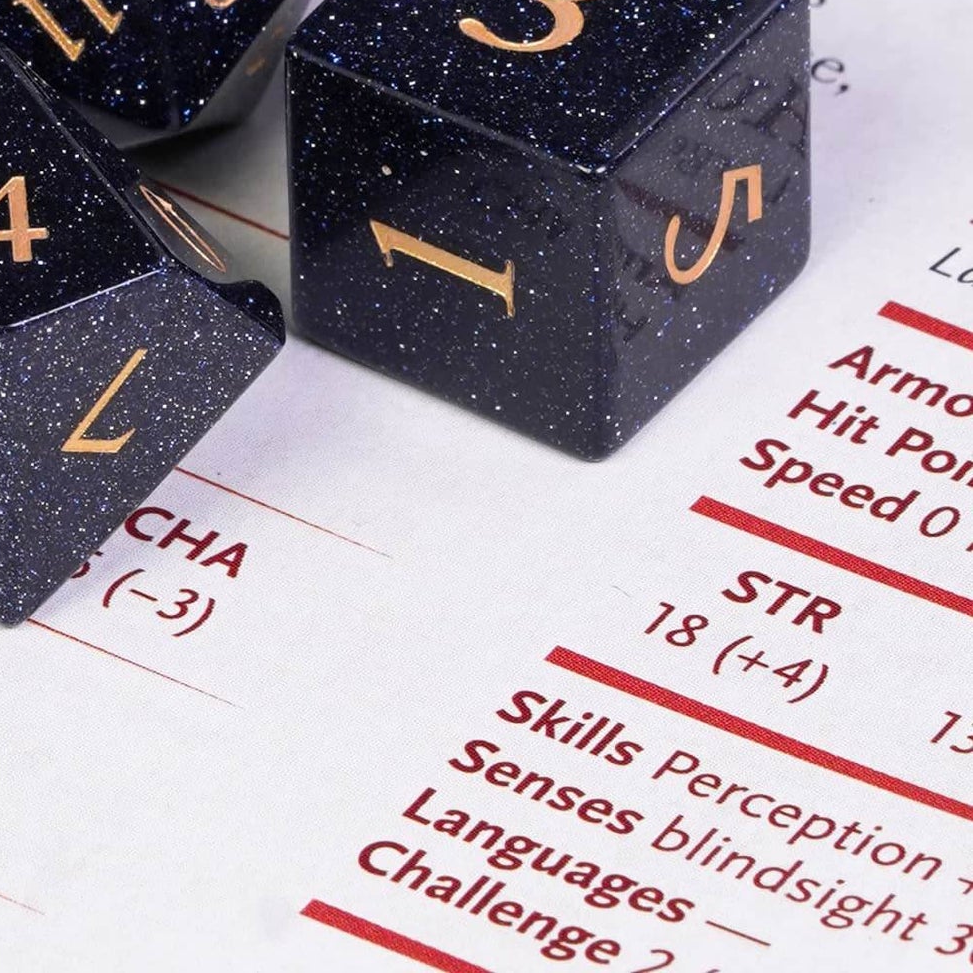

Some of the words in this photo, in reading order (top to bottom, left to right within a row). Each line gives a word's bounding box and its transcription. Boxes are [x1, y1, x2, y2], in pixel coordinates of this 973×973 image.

[369, 219, 516, 320] 1
[663, 163, 763, 286] 5
[59, 348, 148, 454] 7
[787, 389, 880, 445] Hit
[738, 437, 921, 524] Speed
[918, 505, 962, 538] 0
[123, 506, 249, 579] CHA
[643, 601, 710, 648] 18
[711, 635, 830, 705] (+4)
[720, 569, 843, 635] STR
[495, 689, 646, 767] Skills
[650, 749, 944, 882] Perception
[401, 786, 697, 923] Languages
[447, 738, 646, 836] Senses
[649, 813, 929, 942] blindsight
[933, 922, 973, 958] 3
[356, 839, 622, 966] Challenge
